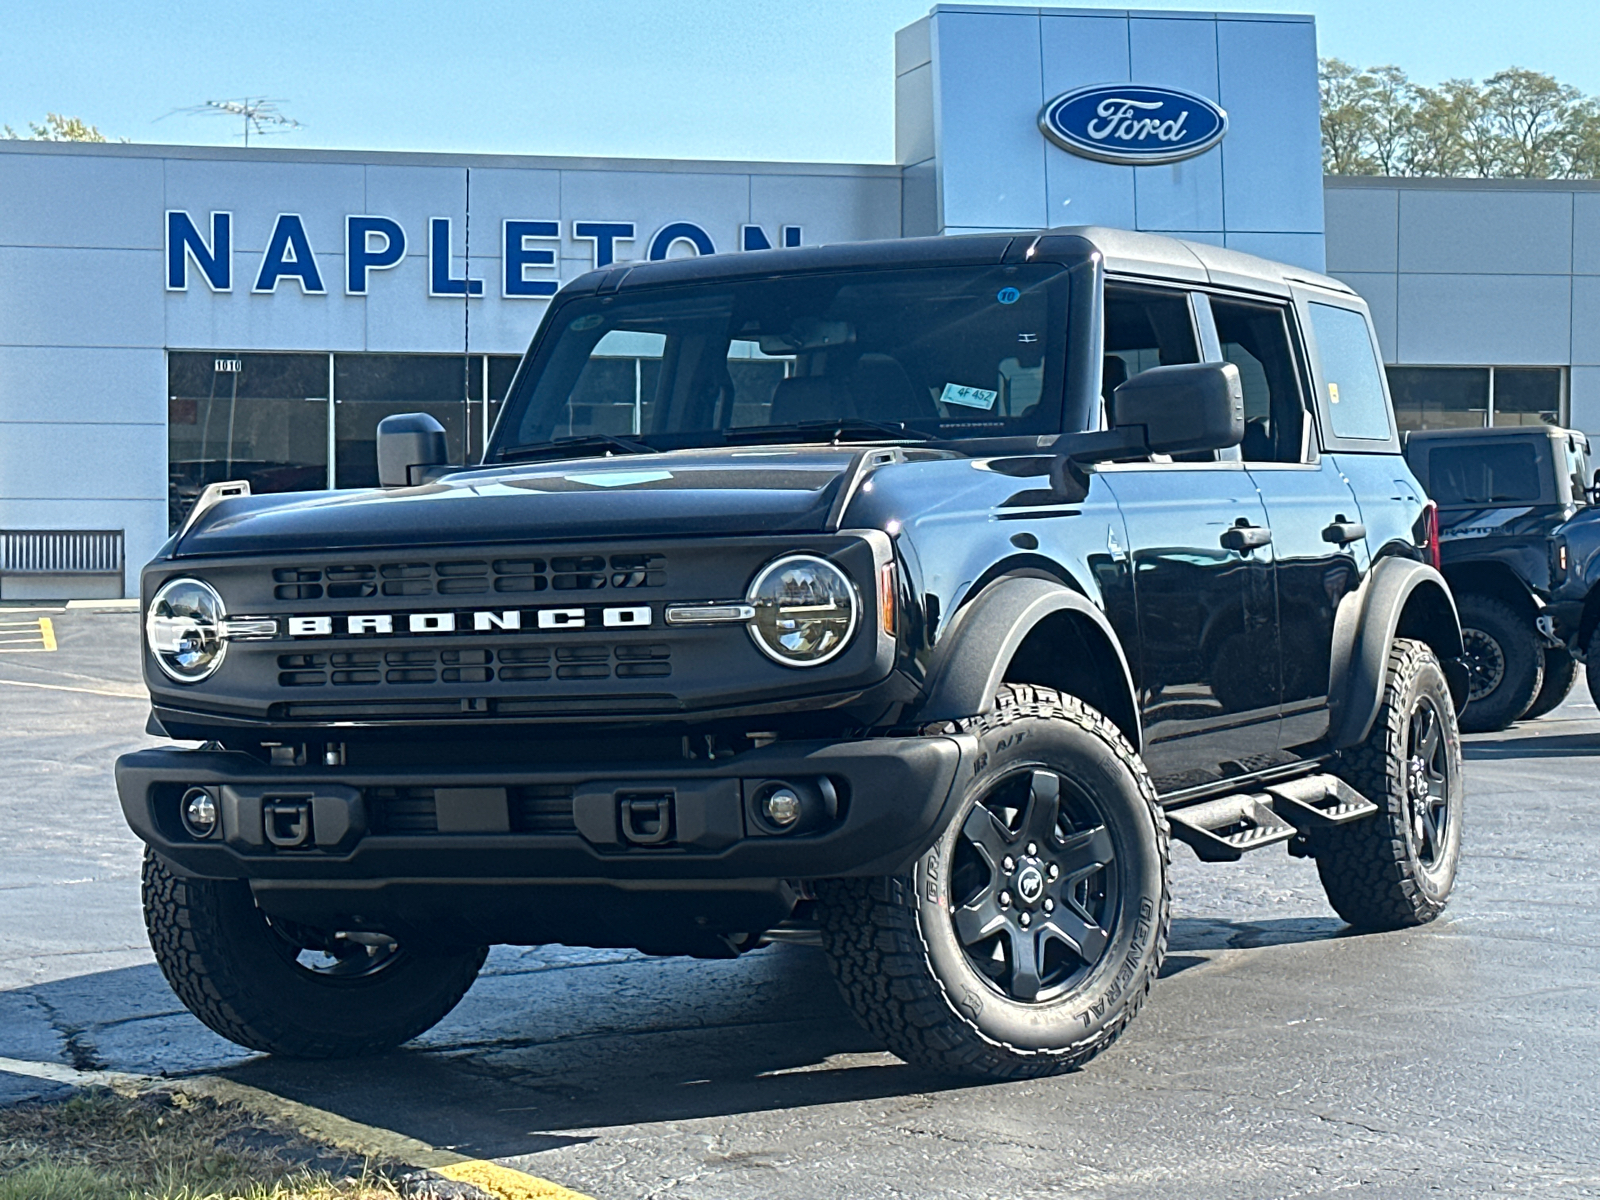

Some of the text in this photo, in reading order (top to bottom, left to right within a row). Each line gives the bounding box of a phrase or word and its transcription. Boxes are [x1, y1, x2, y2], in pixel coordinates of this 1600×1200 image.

[1087, 98, 1188, 141] Ford
[165, 210, 803, 299] NAPLET
[1001, 291, 1015, 302] 10
[215, 359, 242, 371] 1010
[1442, 526, 1507, 537] RAPTOR
[288, 606, 652, 636] BRONCO
[1074, 896, 1154, 1028] GENERAL
